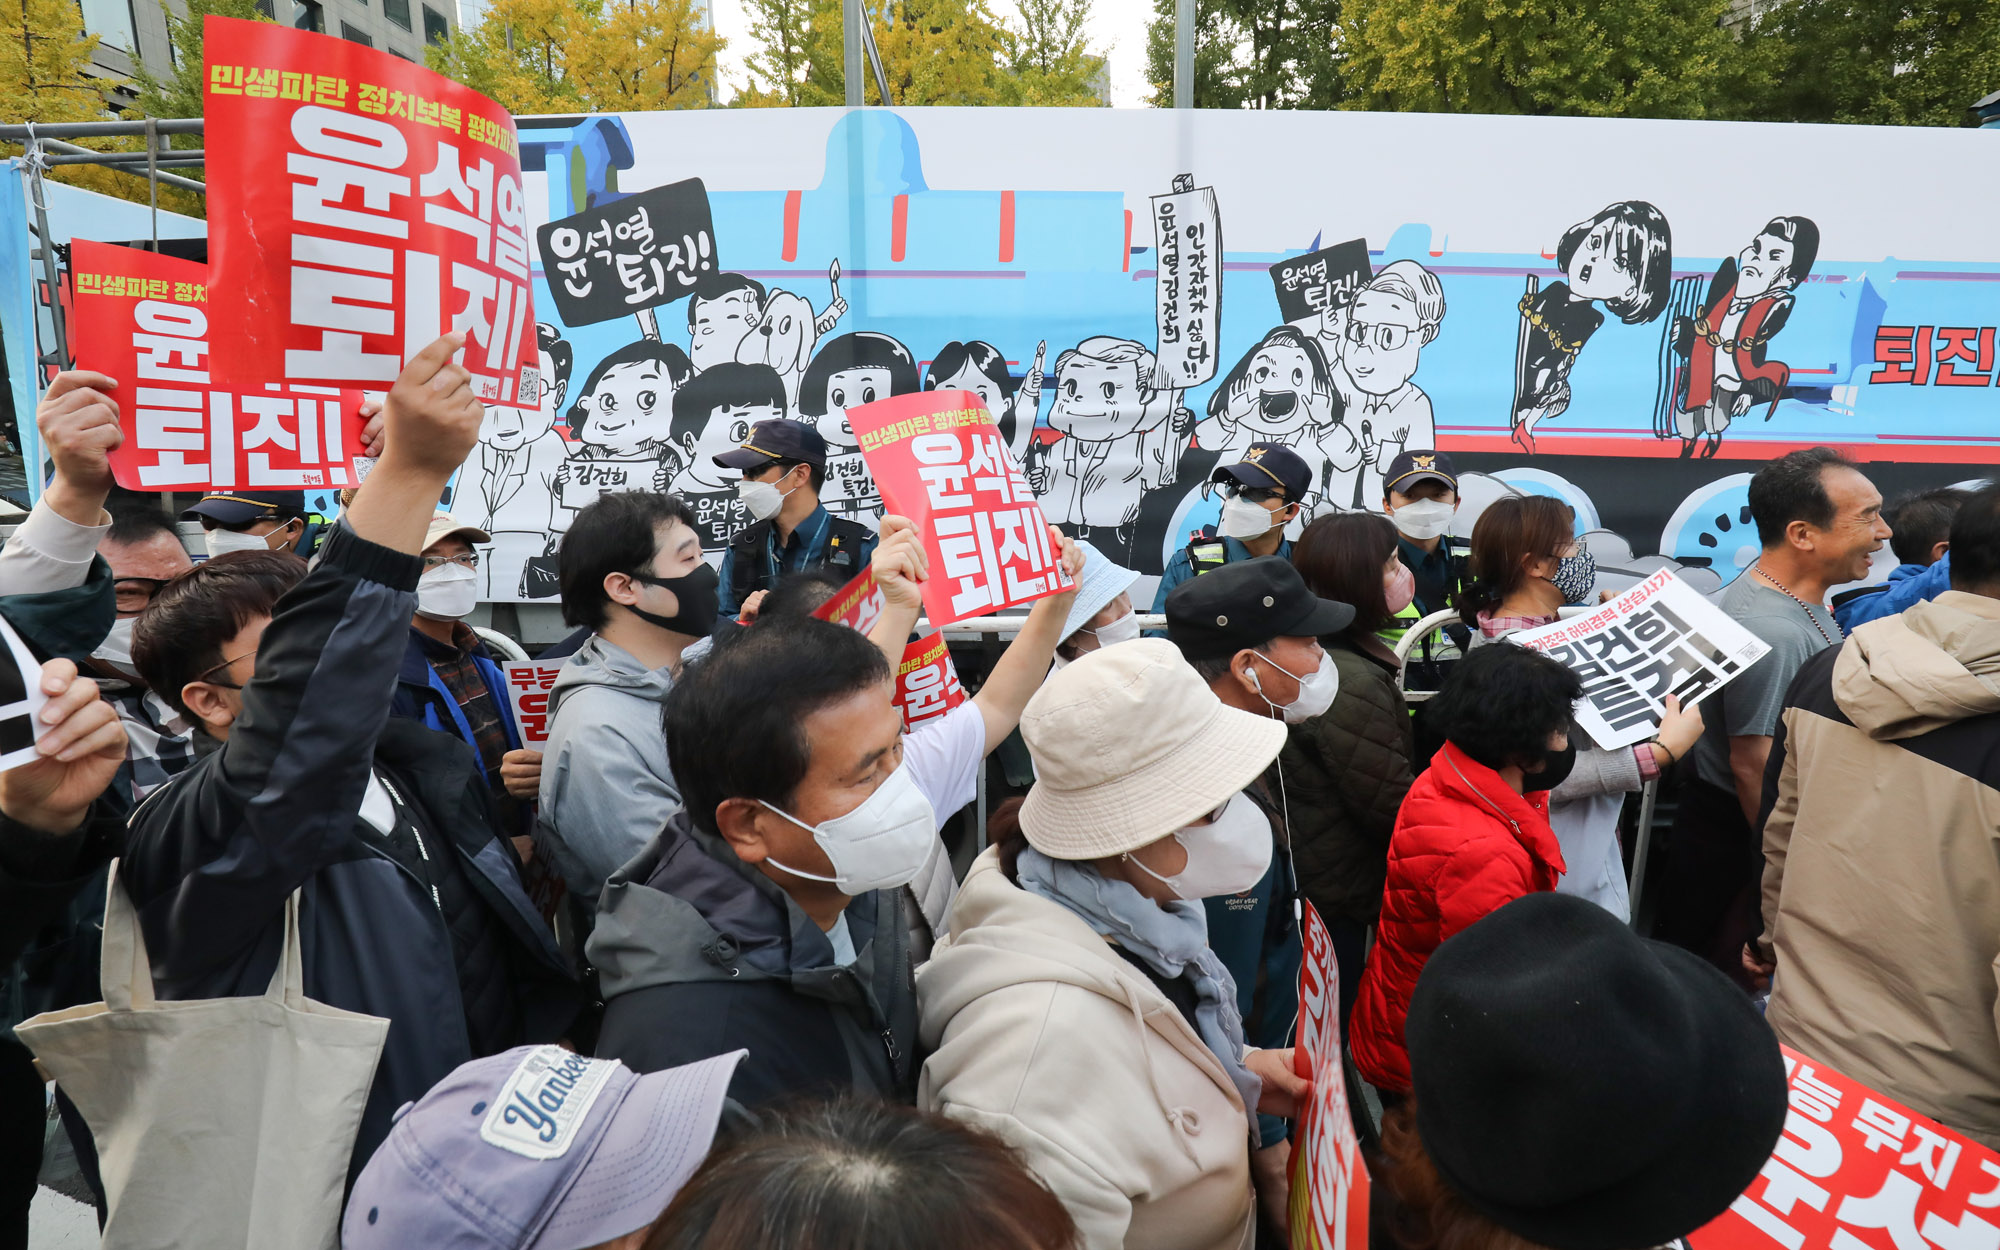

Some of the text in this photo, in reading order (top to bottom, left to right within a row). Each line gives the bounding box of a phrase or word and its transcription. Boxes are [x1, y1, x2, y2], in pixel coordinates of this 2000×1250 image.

[211, 65, 349, 107] 민생파탄
[357, 83, 461, 134] 정치보복
[287, 105, 529, 281] 윤석열
[77, 273, 169, 299] 민생파탄
[550, 206, 656, 297] 윤석열
[615, 230, 710, 304] 퇴진!
[1282, 258, 1327, 291] 윤석열
[285, 233, 527, 401] 퇴진!
[1304, 270, 1358, 311] 퇴진!
[1869, 325, 2000, 387] 퇴진
[136, 387, 349, 486] 퇴진!
[860, 416, 930, 452] 민생파탄
[933, 408, 979, 431] 정치보복
[574, 464, 627, 486] 김건희
[843, 476, 875, 498] 특검!
[696, 498, 746, 525] 윤석열
[934, 507, 1058, 616] 퇴진!
[1567, 607, 1618, 639] 허위경력
[1617, 569, 1673, 614] 상습사기
[504, 1053, 593, 1142] Yankee
[1851, 1097, 1962, 1191] 무지
